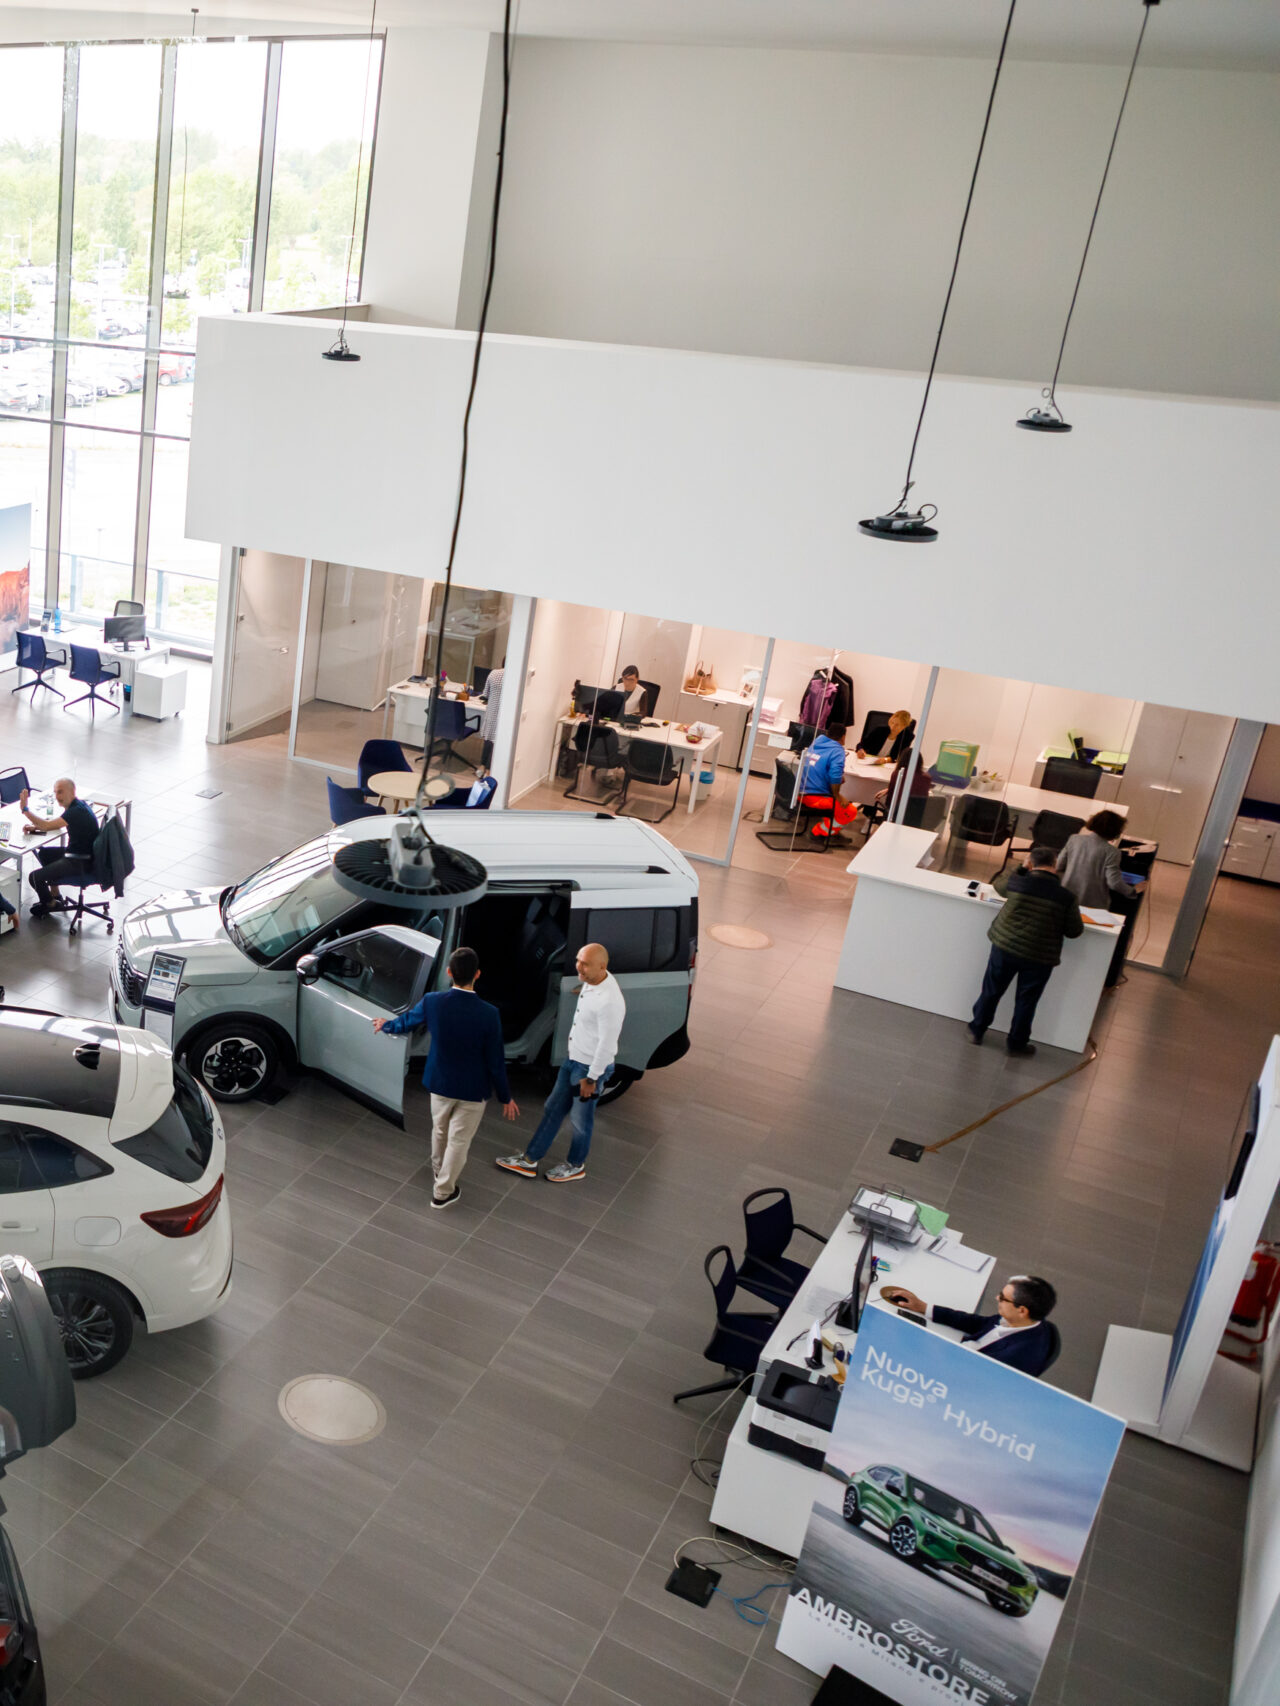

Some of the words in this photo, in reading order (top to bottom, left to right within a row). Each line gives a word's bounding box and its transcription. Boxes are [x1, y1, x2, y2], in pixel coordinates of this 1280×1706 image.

[865, 1345, 949, 1400] Nuova
[943, 1403, 1036, 1463] Hybrid
[794, 1586, 990, 1706] AMBROSTORE
[891, 1618, 949, 1658] Ford
[959, 1665, 1018, 1701] TOMORROW
